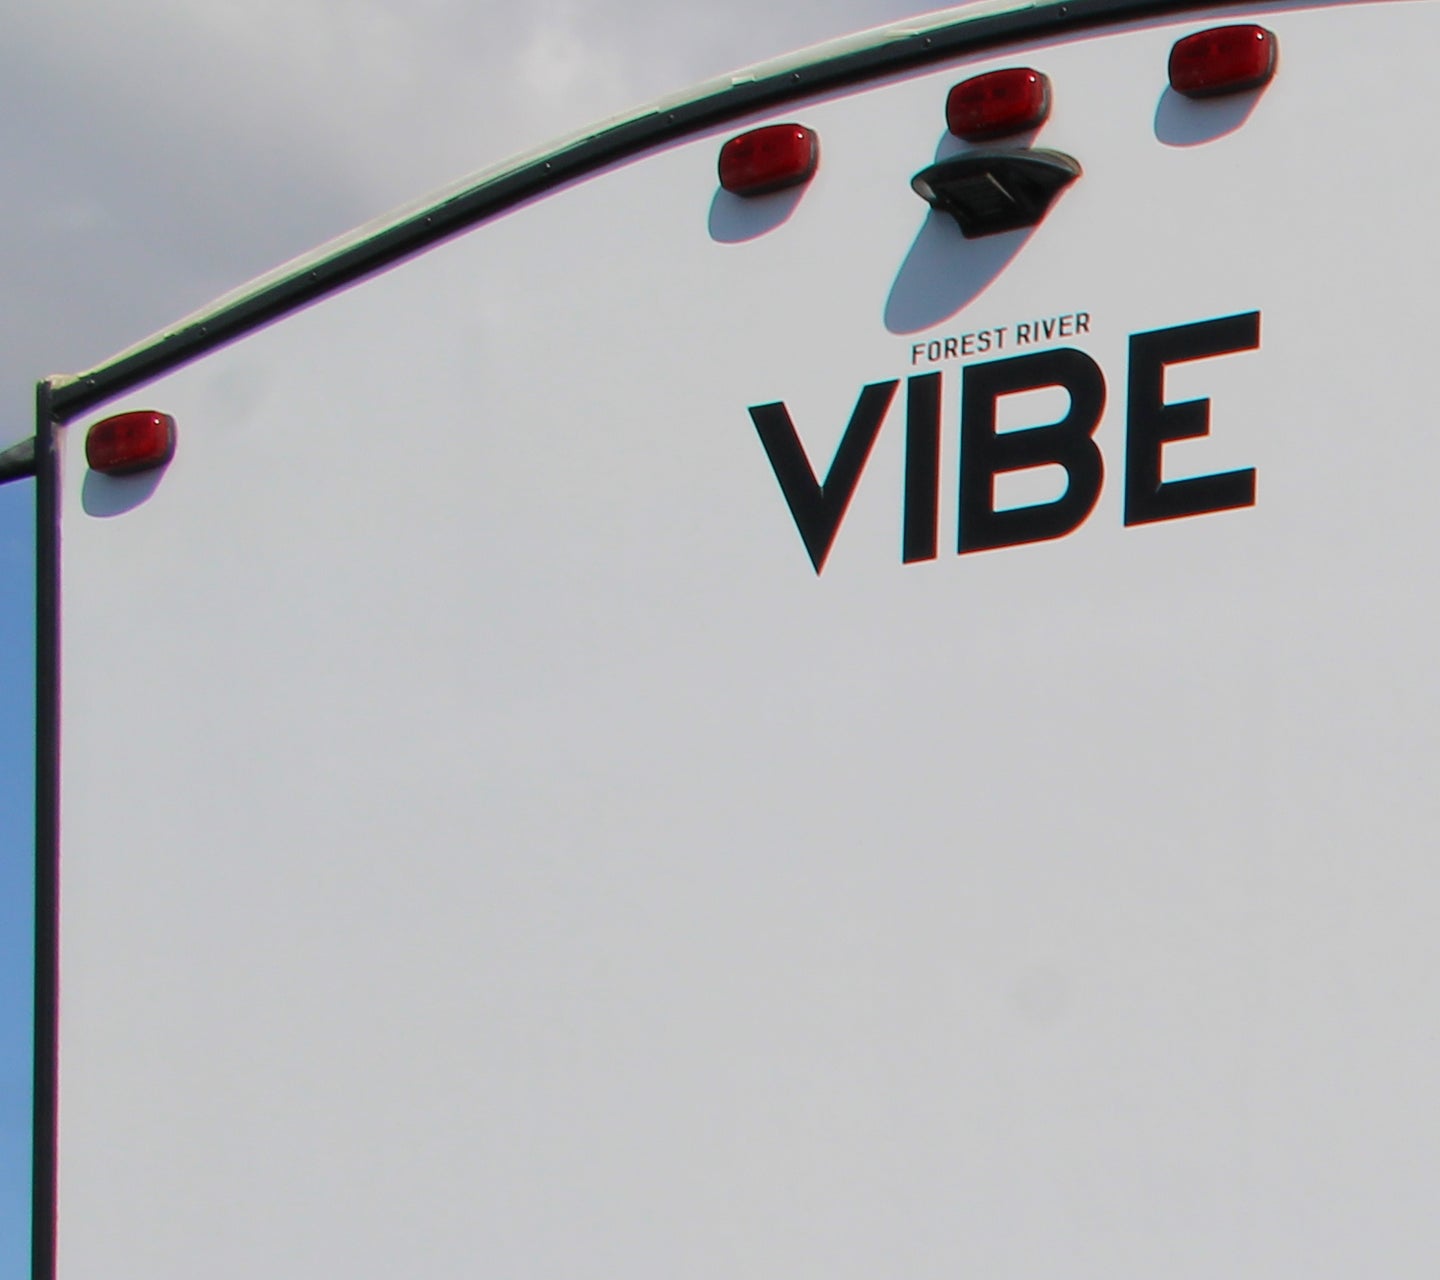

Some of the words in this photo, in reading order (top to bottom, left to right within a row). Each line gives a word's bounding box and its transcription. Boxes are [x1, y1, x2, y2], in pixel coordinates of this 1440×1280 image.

[911, 328, 1008, 365] FOREST
[1016, 312, 1091, 346] RIVER
[747, 310, 1262, 577] VIBE
